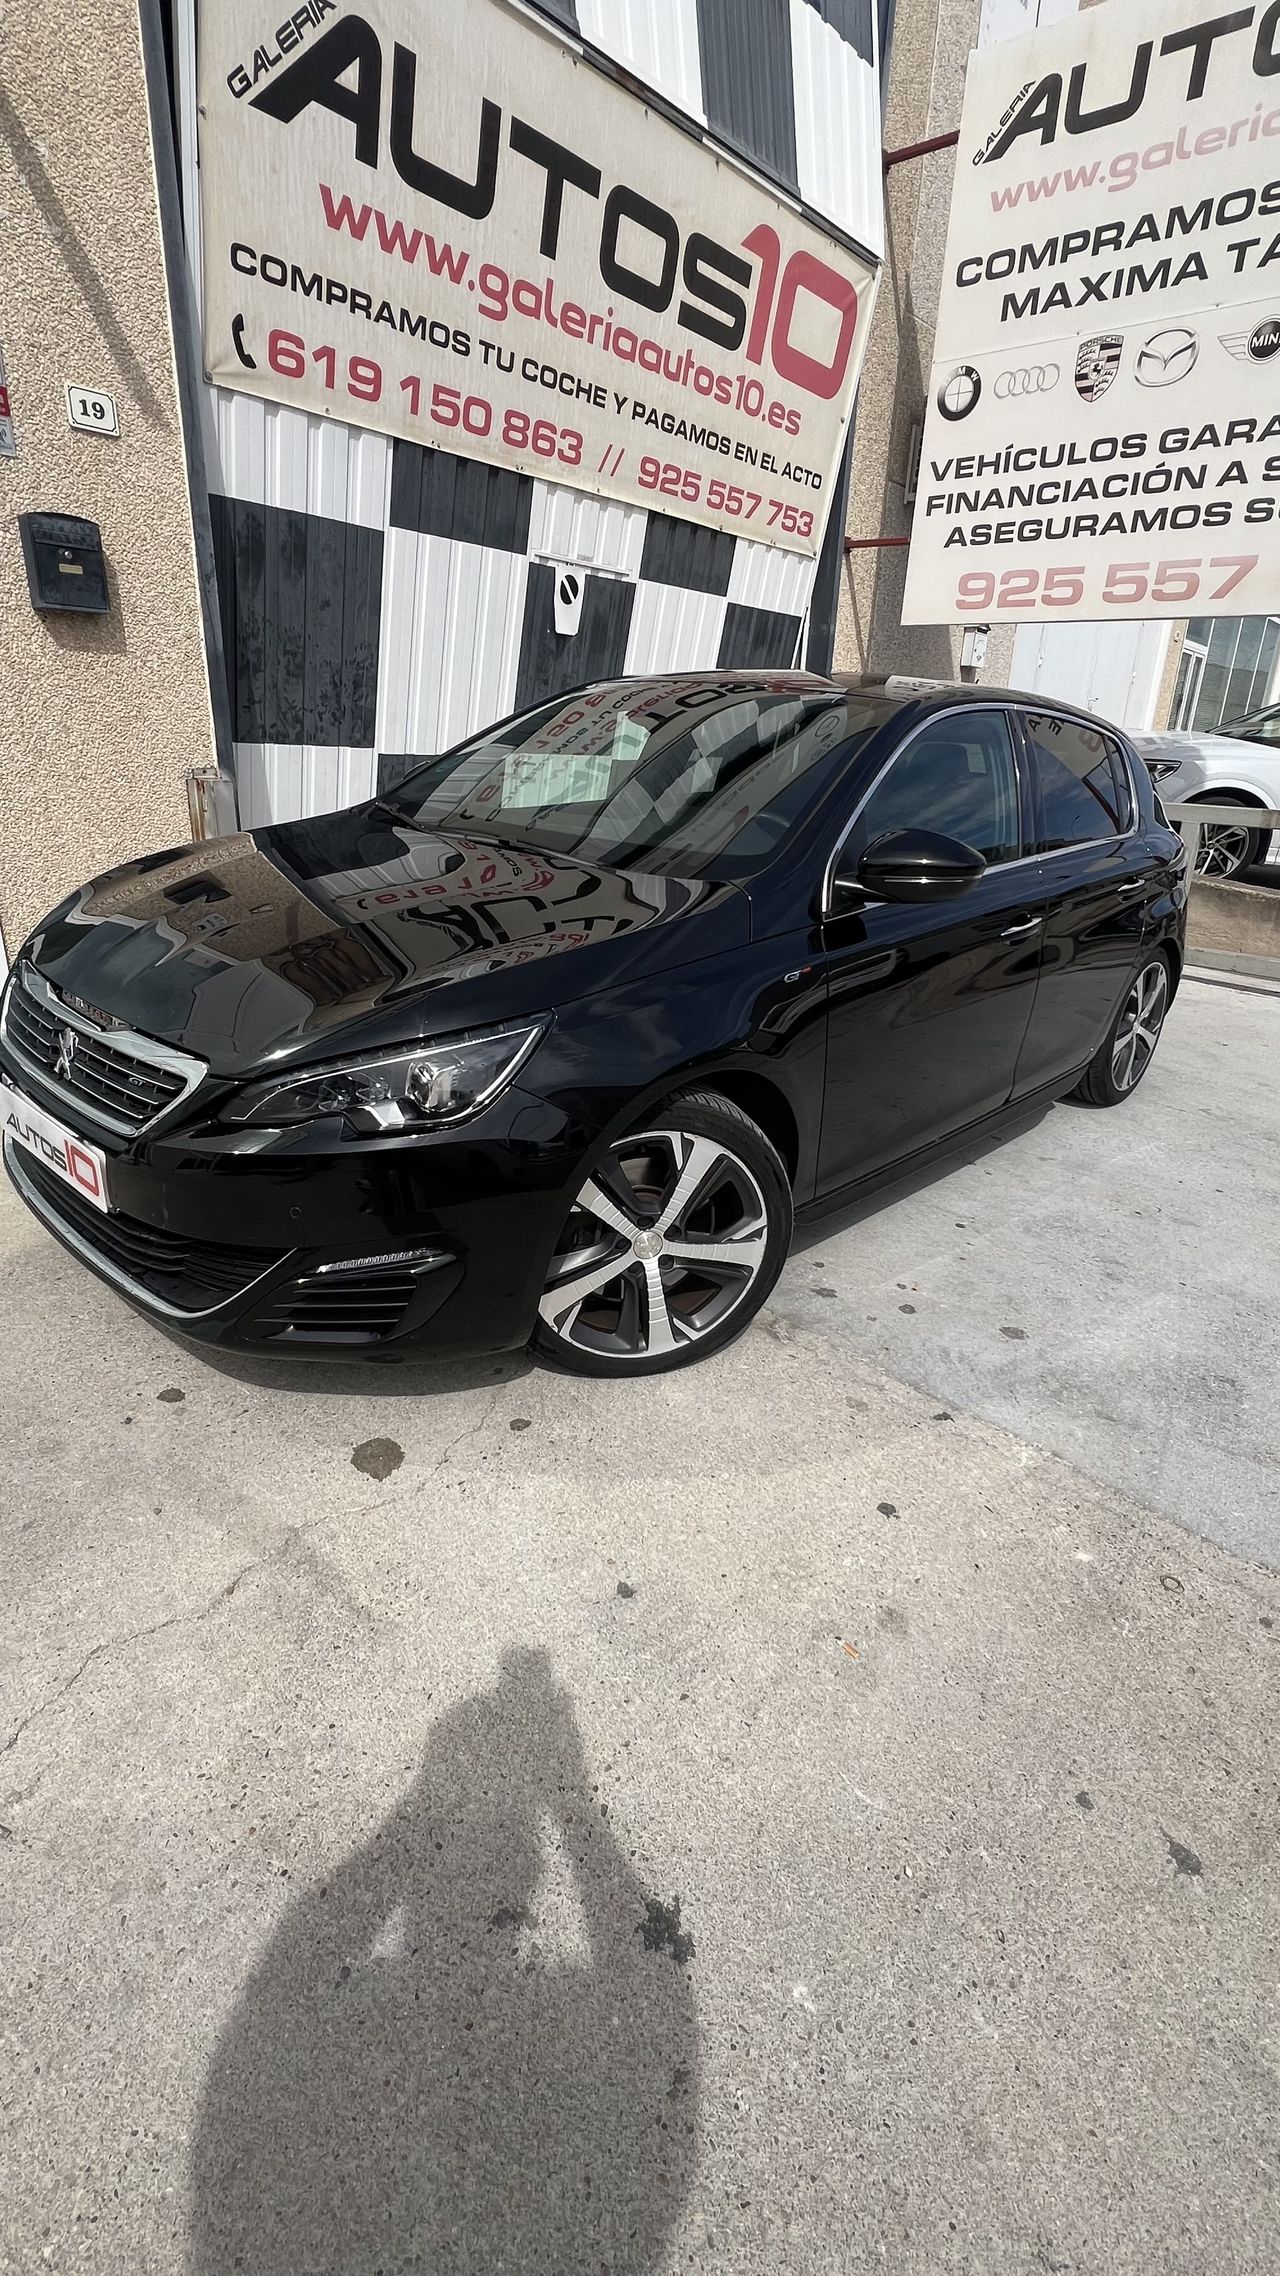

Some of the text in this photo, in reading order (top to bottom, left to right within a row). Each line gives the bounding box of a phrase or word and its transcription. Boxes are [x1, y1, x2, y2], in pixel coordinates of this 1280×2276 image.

[227, 0, 337, 98] GALERIA
[972, 80, 1036, 167] GALERIA
[319, 183, 801, 436] www.galeriaautos10.es
[1001, 251, 1209, 322] MAXIMA
[231, 243, 822, 491] COMPRAMOS TU COCHE Y PAGAMOS EN EL ACTO
[1251, 335, 1280, 348] MIN
[79, 399, 105, 420] 19
[267, 329, 382, 402] 619
[400, 375, 492, 436] 150
[503, 409, 584, 465] 863
[638, 455, 702, 502] 925
[707, 481, 761, 519] 557
[767, 500, 813, 537] 753
[930, 414, 1280, 481] VEHÍCULOS GARA
[926, 462, 1207, 516] FINANCIACIÓN
[1215, 460, 1248, 487] A
[943, 497, 1280, 548] ASEGURAMOS S
[955, 554, 1259, 610] 925 557
